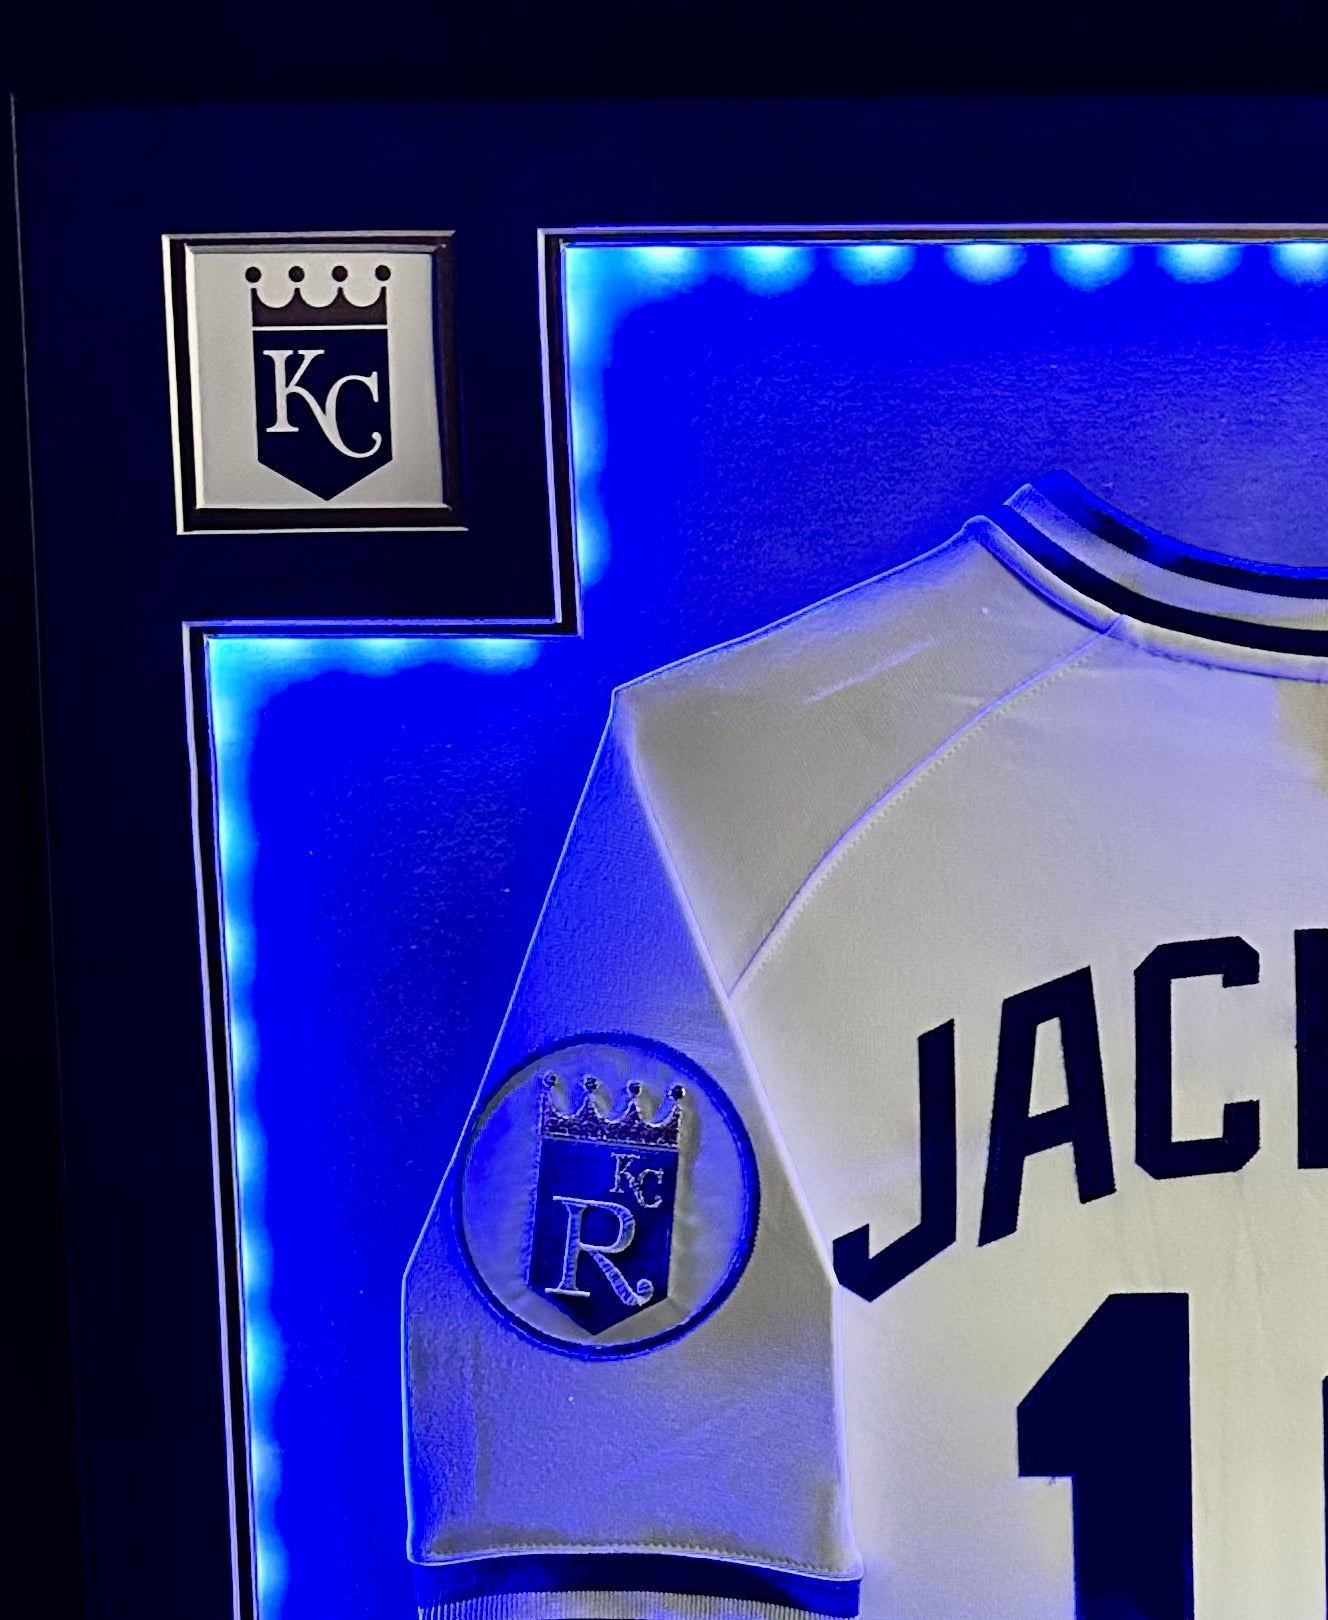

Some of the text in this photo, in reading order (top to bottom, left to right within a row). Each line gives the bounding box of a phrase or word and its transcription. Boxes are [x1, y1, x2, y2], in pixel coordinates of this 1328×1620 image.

[263, 349, 382, 459] KC
[609, 1152, 664, 1208] KC
[545, 1195, 654, 1306] R
